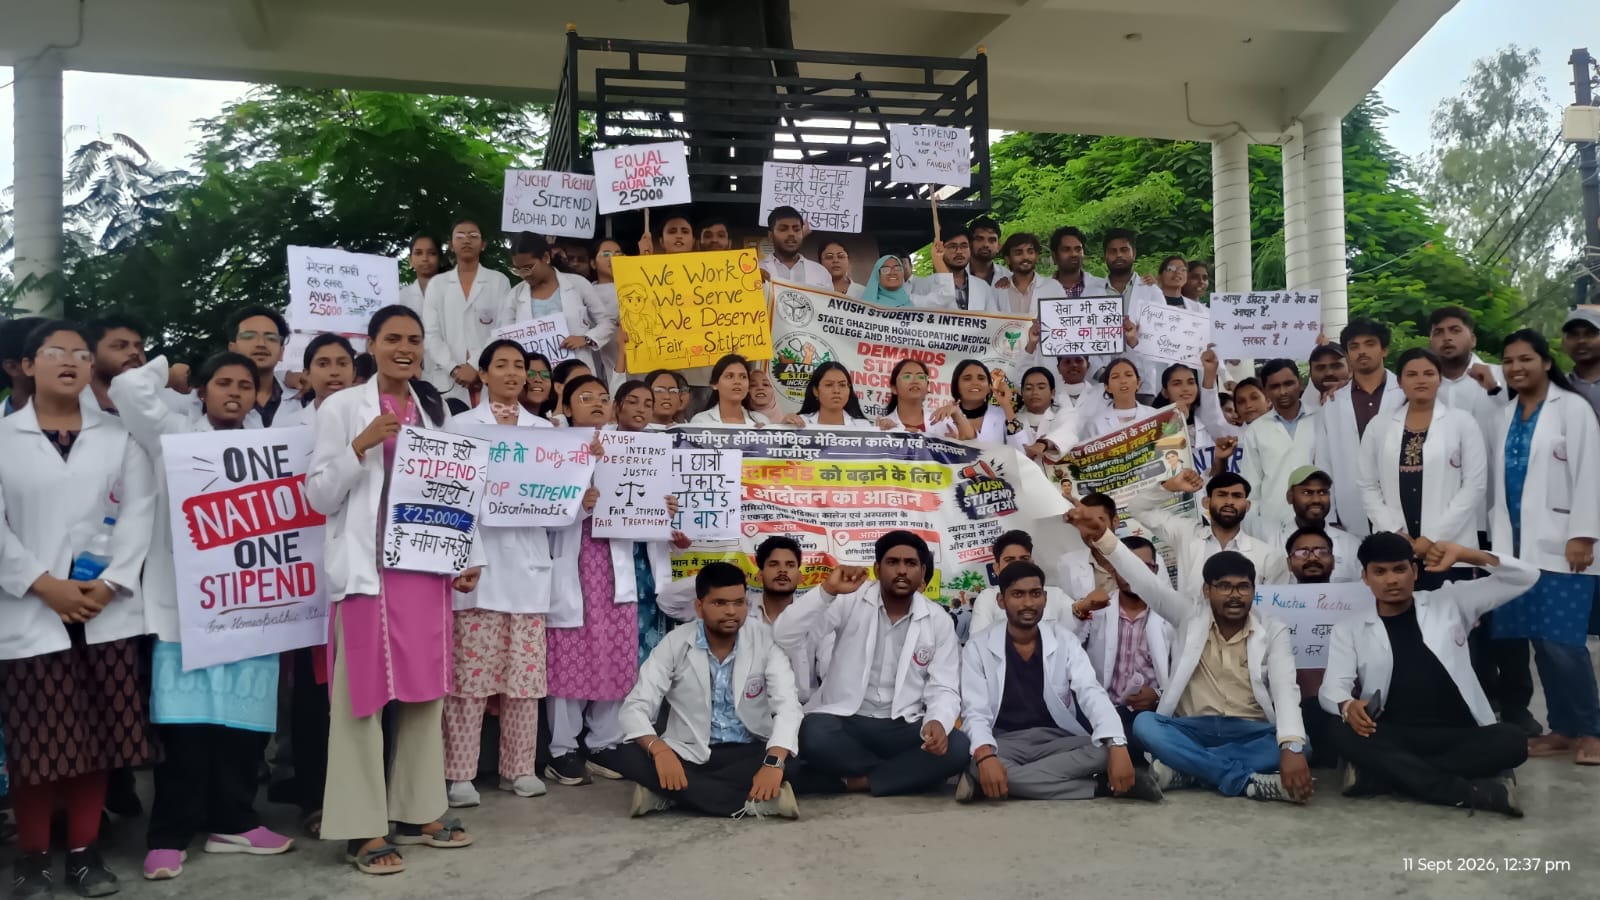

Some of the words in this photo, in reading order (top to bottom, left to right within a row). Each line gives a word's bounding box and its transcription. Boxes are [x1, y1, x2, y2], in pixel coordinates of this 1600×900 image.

[912, 127, 957, 139] STIPEND
[615, 150, 669, 168] EQUAL
[625, 165, 662, 180] WORK
[612, 179, 650, 192] EQUAL
[653, 176, 675, 187] PAY
[533, 190, 592, 211] STIPEND
[619, 189, 663, 206] 25000
[512, 209, 547, 225] BADHA
[552, 214, 566, 226] DO
[575, 216, 591, 230] NA
[640, 264, 673, 286] We
[683, 260, 739, 283] Work
[653, 289, 682, 306] We
[693, 286, 742, 305] Serve
[310, 303, 342, 315] 25000
[828, 299, 865, 314] AYUSH
[868, 303, 924, 322] STUDENTS
[927, 314, 935, 324] &
[939, 316, 987, 329] INTERNS
[658, 309, 691, 330] We
[701, 307, 766, 326] Deserve
[818, 314, 844, 325] STATE
[846, 319, 889, 333] GHAZIPUR
[892, 327, 959, 341] HOMOEOPATHIC
[962, 335, 991, 344] MEDICAL
[656, 336, 684, 355] Fair
[704, 327, 766, 352] Stipend
[822, 325, 862, 338] COLLEGE
[885, 336, 925, 348] HOSPITAL
[928, 341, 968, 352] GHAZIPUR
[969, 345, 986, 354] (U.P)
[857, 342, 946, 365] DEMANDS
[784, 364, 813, 374] AYU
[406, 429, 448, 456] मेहनत
[602, 434, 635, 445] AYUSH
[815, 433, 862, 447] मेडिकल
[866, 435, 903, 447] कालेज
[908, 437, 924, 449] एवं
[536, 446, 565, 468] Duty
[603, 456, 652, 464] DESERVE
[626, 446, 666, 456] INTERNS
[223, 445, 293, 483] ONE
[405, 458, 476, 481] STIPEND
[623, 468, 657, 477] JUSTICE
[820, 465, 842, 481] को
[846, 465, 887, 484] बढ़ाने
[891, 465, 906, 481] के
[911, 469, 942, 485] लिए
[965, 480, 1004, 496] AYUSH
[832, 491, 858, 504] का
[964, 489, 1011, 507] STIPEND
[609, 506, 625, 515] FAIR
[636, 508, 665, 516] STIPEND
[595, 518, 612, 527] FAIR
[623, 517, 669, 526] TREATMENT
[234, 532, 302, 569] ONE
[200, 562, 316, 609] STIPEND
[1272, 593, 1306, 608] Kuchu
[1316, 594, 1352, 610] Puchu
